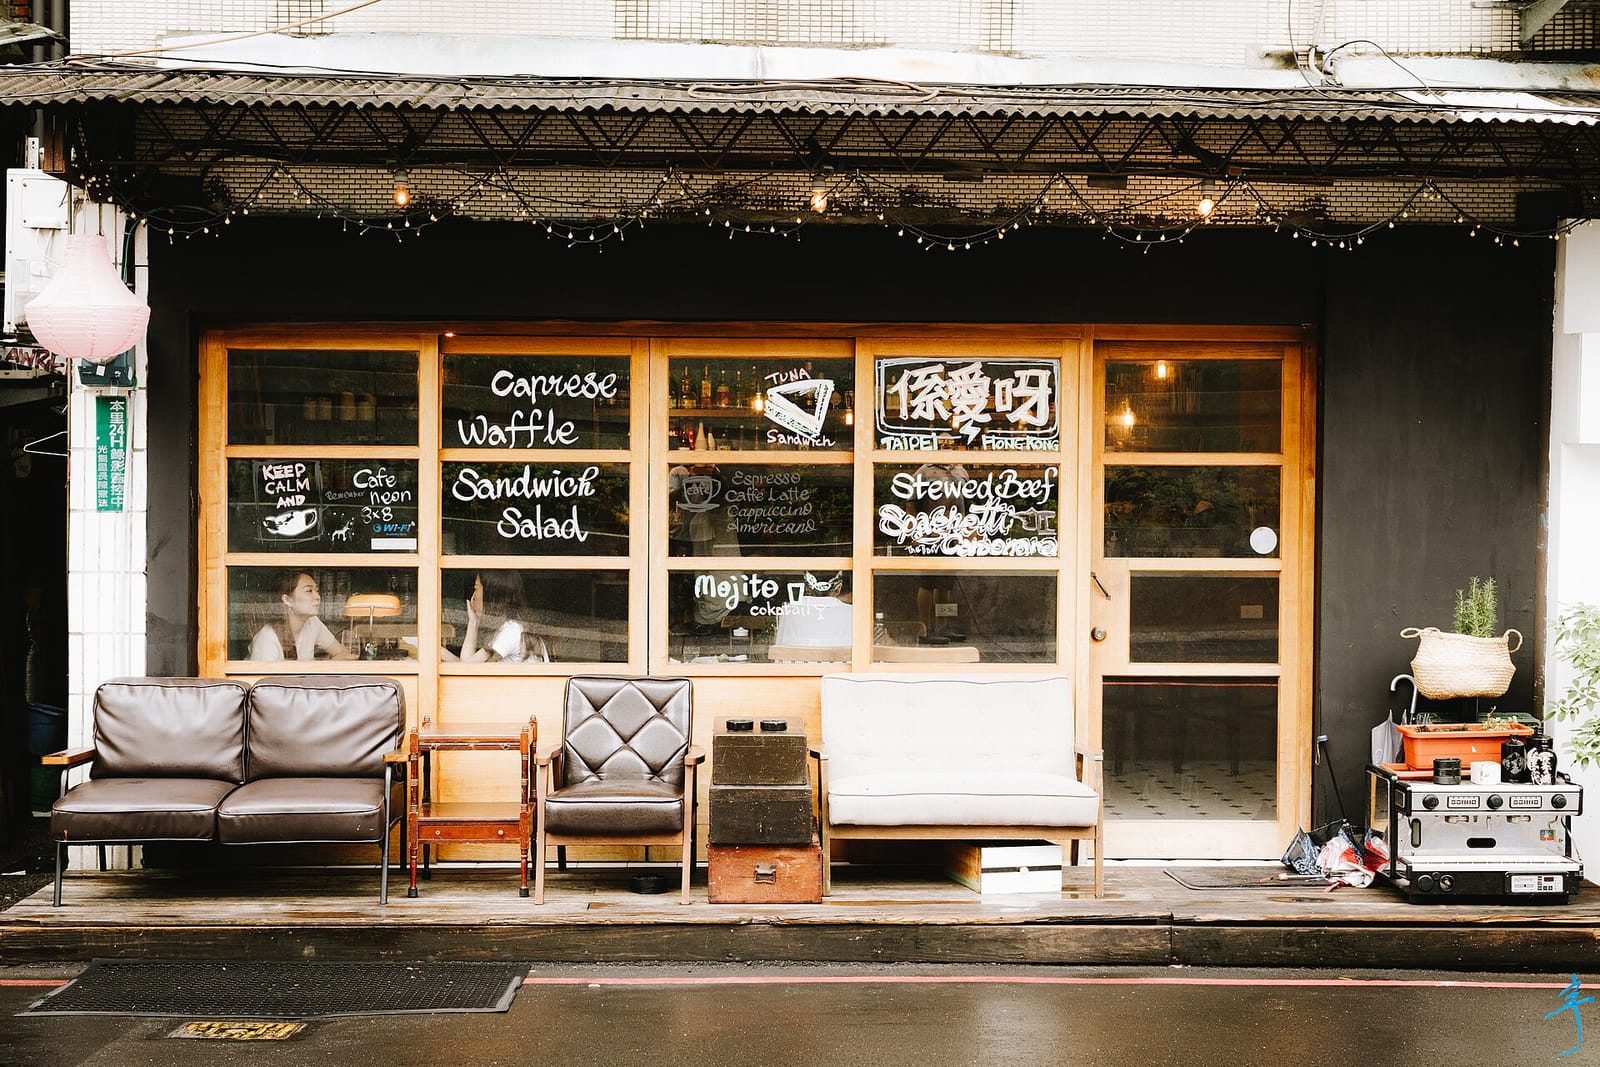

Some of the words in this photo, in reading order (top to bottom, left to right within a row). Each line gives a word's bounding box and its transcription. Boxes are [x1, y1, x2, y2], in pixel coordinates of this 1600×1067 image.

[764, 368, 811, 385] TUNA
[491, 369, 618, 405] Caprese
[887, 361, 1053, 426] 係愛呀
[457, 408, 579, 449] Waffle
[766, 429, 836, 447] Sandwich
[881, 433, 939, 450] TAIPEI
[262, 463, 306, 480] KEEP
[353, 467, 397, 489] Cafe
[731, 470, 801, 489] Espresso
[265, 478, 310, 494] CALM
[452, 464, 599, 501] Sandwich
[891, 472, 993, 501] Stewed
[994, 467, 1058, 505] Beef
[276, 494, 306, 509] AND
[370, 490, 412, 505] neon
[767, 485, 810, 502] Latte
[383, 523, 412, 532] Wi-Fi
[497, 503, 588, 542] Salad
[726, 518, 818, 533] Americano
[694, 573, 779, 610] Mojito
